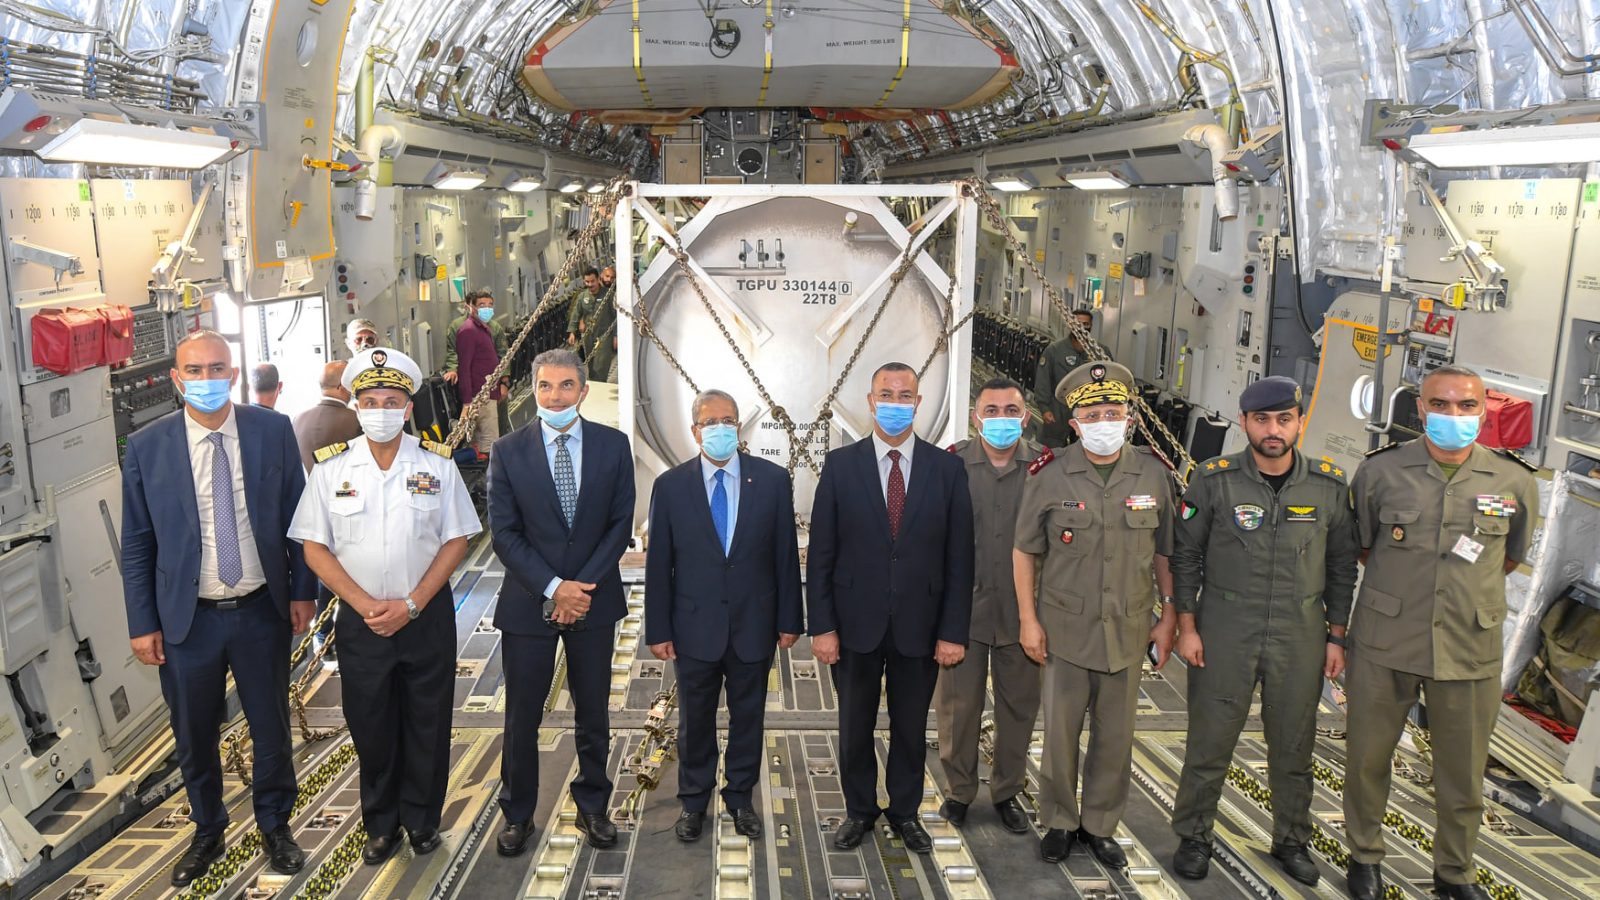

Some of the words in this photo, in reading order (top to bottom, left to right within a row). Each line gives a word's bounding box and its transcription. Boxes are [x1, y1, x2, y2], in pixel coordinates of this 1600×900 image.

[25, 207, 41, 219] 1200
[65, 206, 80, 217] 1190
[1470, 204, 1484, 214] 1160
[1508, 204, 1523, 215] 1170
[1550, 205, 1567, 216] 1180
[737, 279, 777, 291] TGPU
[783, 280, 837, 292] 330144
[803, 293, 837, 305] 22T8
[1364, 346, 1377, 359] EXIT
[760, 448, 781, 456] TARE
